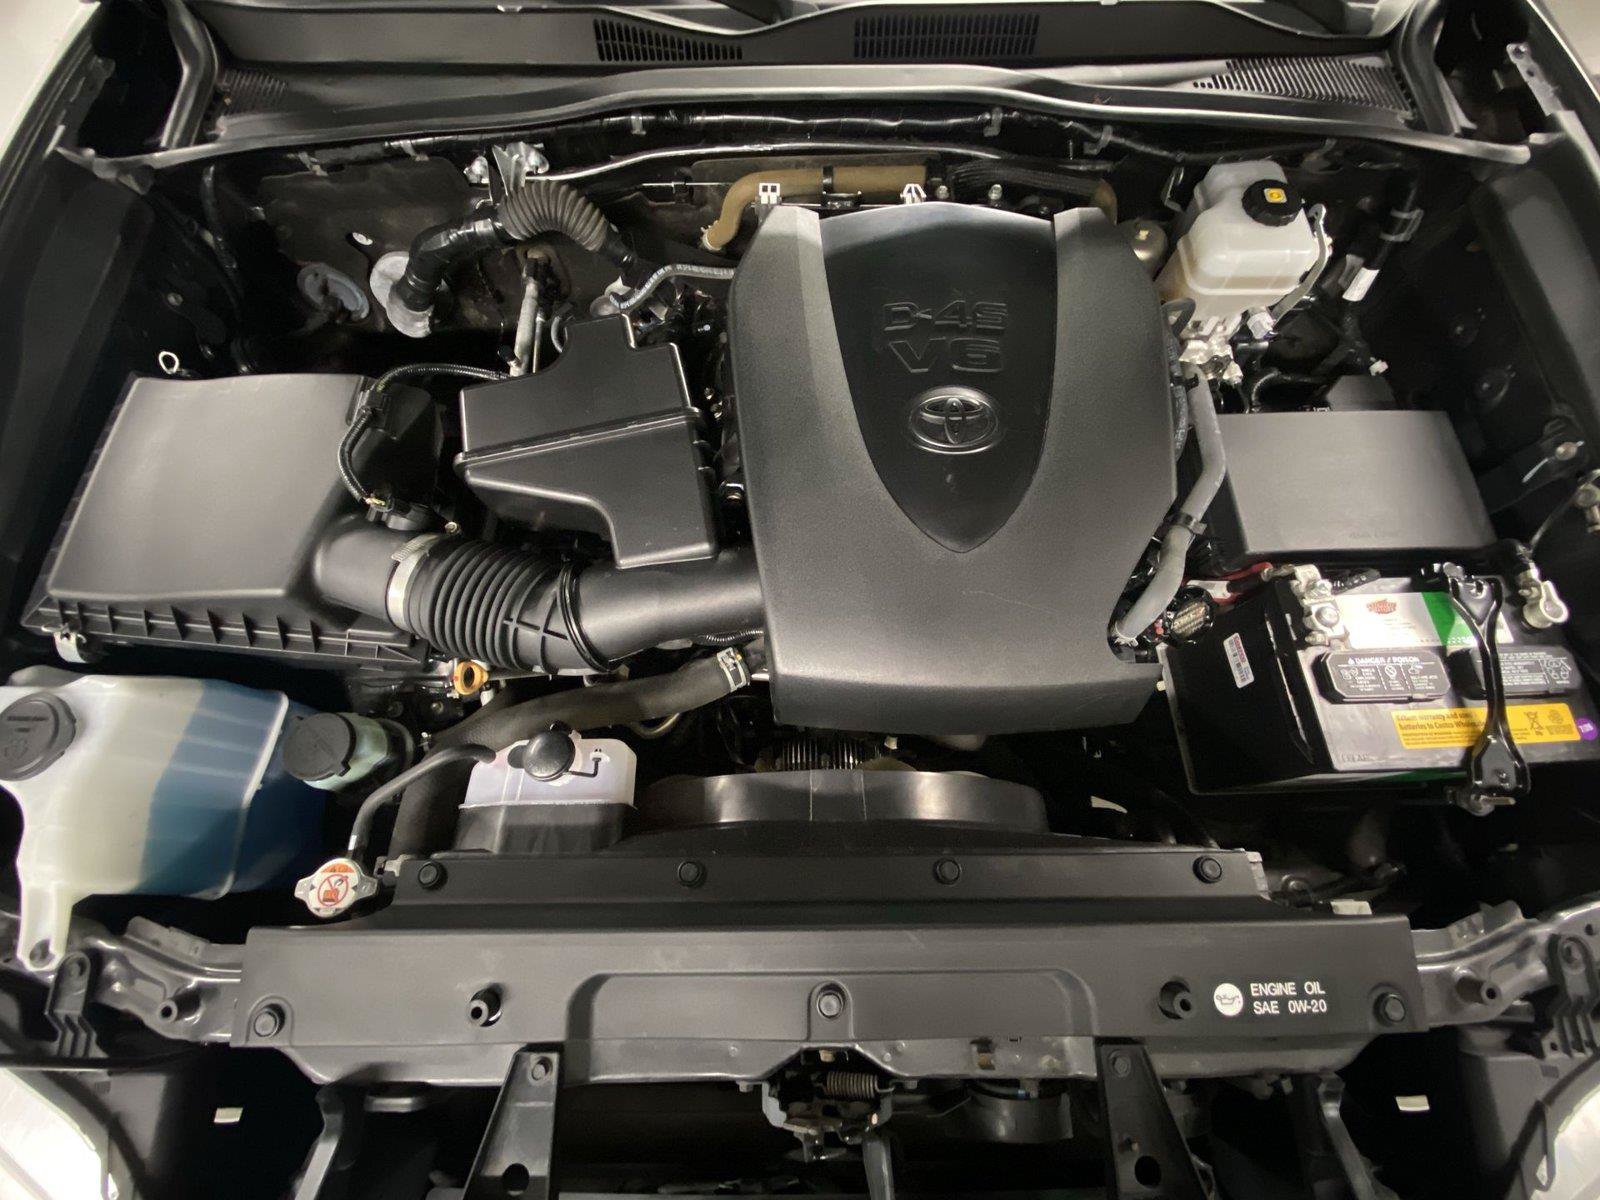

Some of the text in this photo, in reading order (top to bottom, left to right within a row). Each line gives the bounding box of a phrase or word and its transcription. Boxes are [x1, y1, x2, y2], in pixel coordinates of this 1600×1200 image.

[884, 300, 1008, 332] D-4S
[888, 336, 1003, 373] V6
[1355, 655, 1385, 665] DANGER
[1250, 981, 1326, 996] ENGINE OIL
[1253, 999, 1328, 1015] SAE 0W-20
